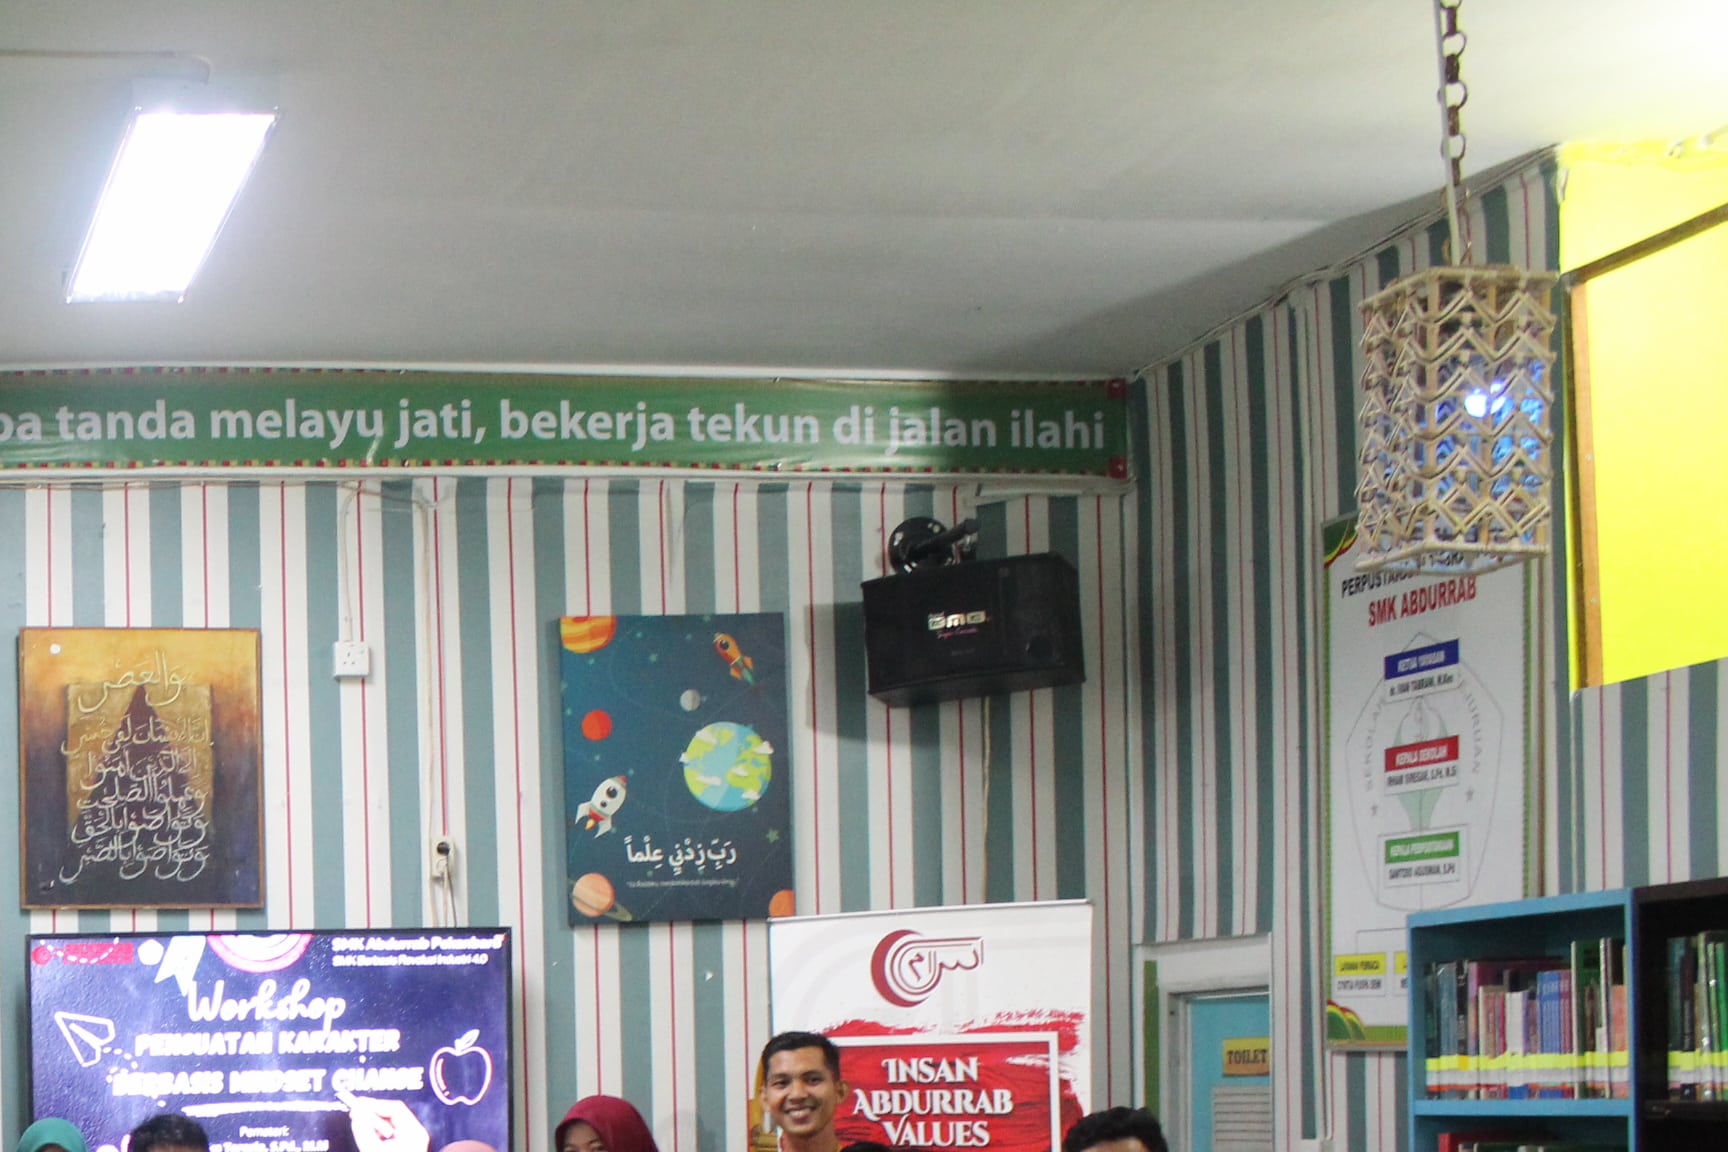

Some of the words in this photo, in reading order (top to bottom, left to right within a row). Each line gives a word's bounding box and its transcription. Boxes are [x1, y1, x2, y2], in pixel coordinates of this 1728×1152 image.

[56, 399, 196, 442] tanda
[210, 399, 385, 448] melayu
[394, 398, 486, 448] jati,
[500, 399, 674, 451] bekerja
[687, 403, 820, 444] tekun
[833, 405, 874, 444] di
[884, 406, 998, 457] jalan
[1011, 408, 1104, 450] ilahi
[1368, 595, 1397, 627] SMK
[1400, 575, 1477, 618] ABDURRAB
[331, 937, 365, 951] SMK
[188, 978, 346, 1034] Workshop
[135, 1031, 275, 1057] PENGUATAN
[278, 1029, 400, 1054] KARAKTER
[1227, 1048, 1269, 1065] TOILET
[112, 1066, 224, 1098] BERBASIS
[229, 1068, 325, 1094] MINDSET
[332, 1066, 424, 1093] CHANGE
[881, 1057, 979, 1084] INSAN
[852, 1088, 1014, 1122] ABDURRAB
[881, 1114, 991, 1148] VALUES
